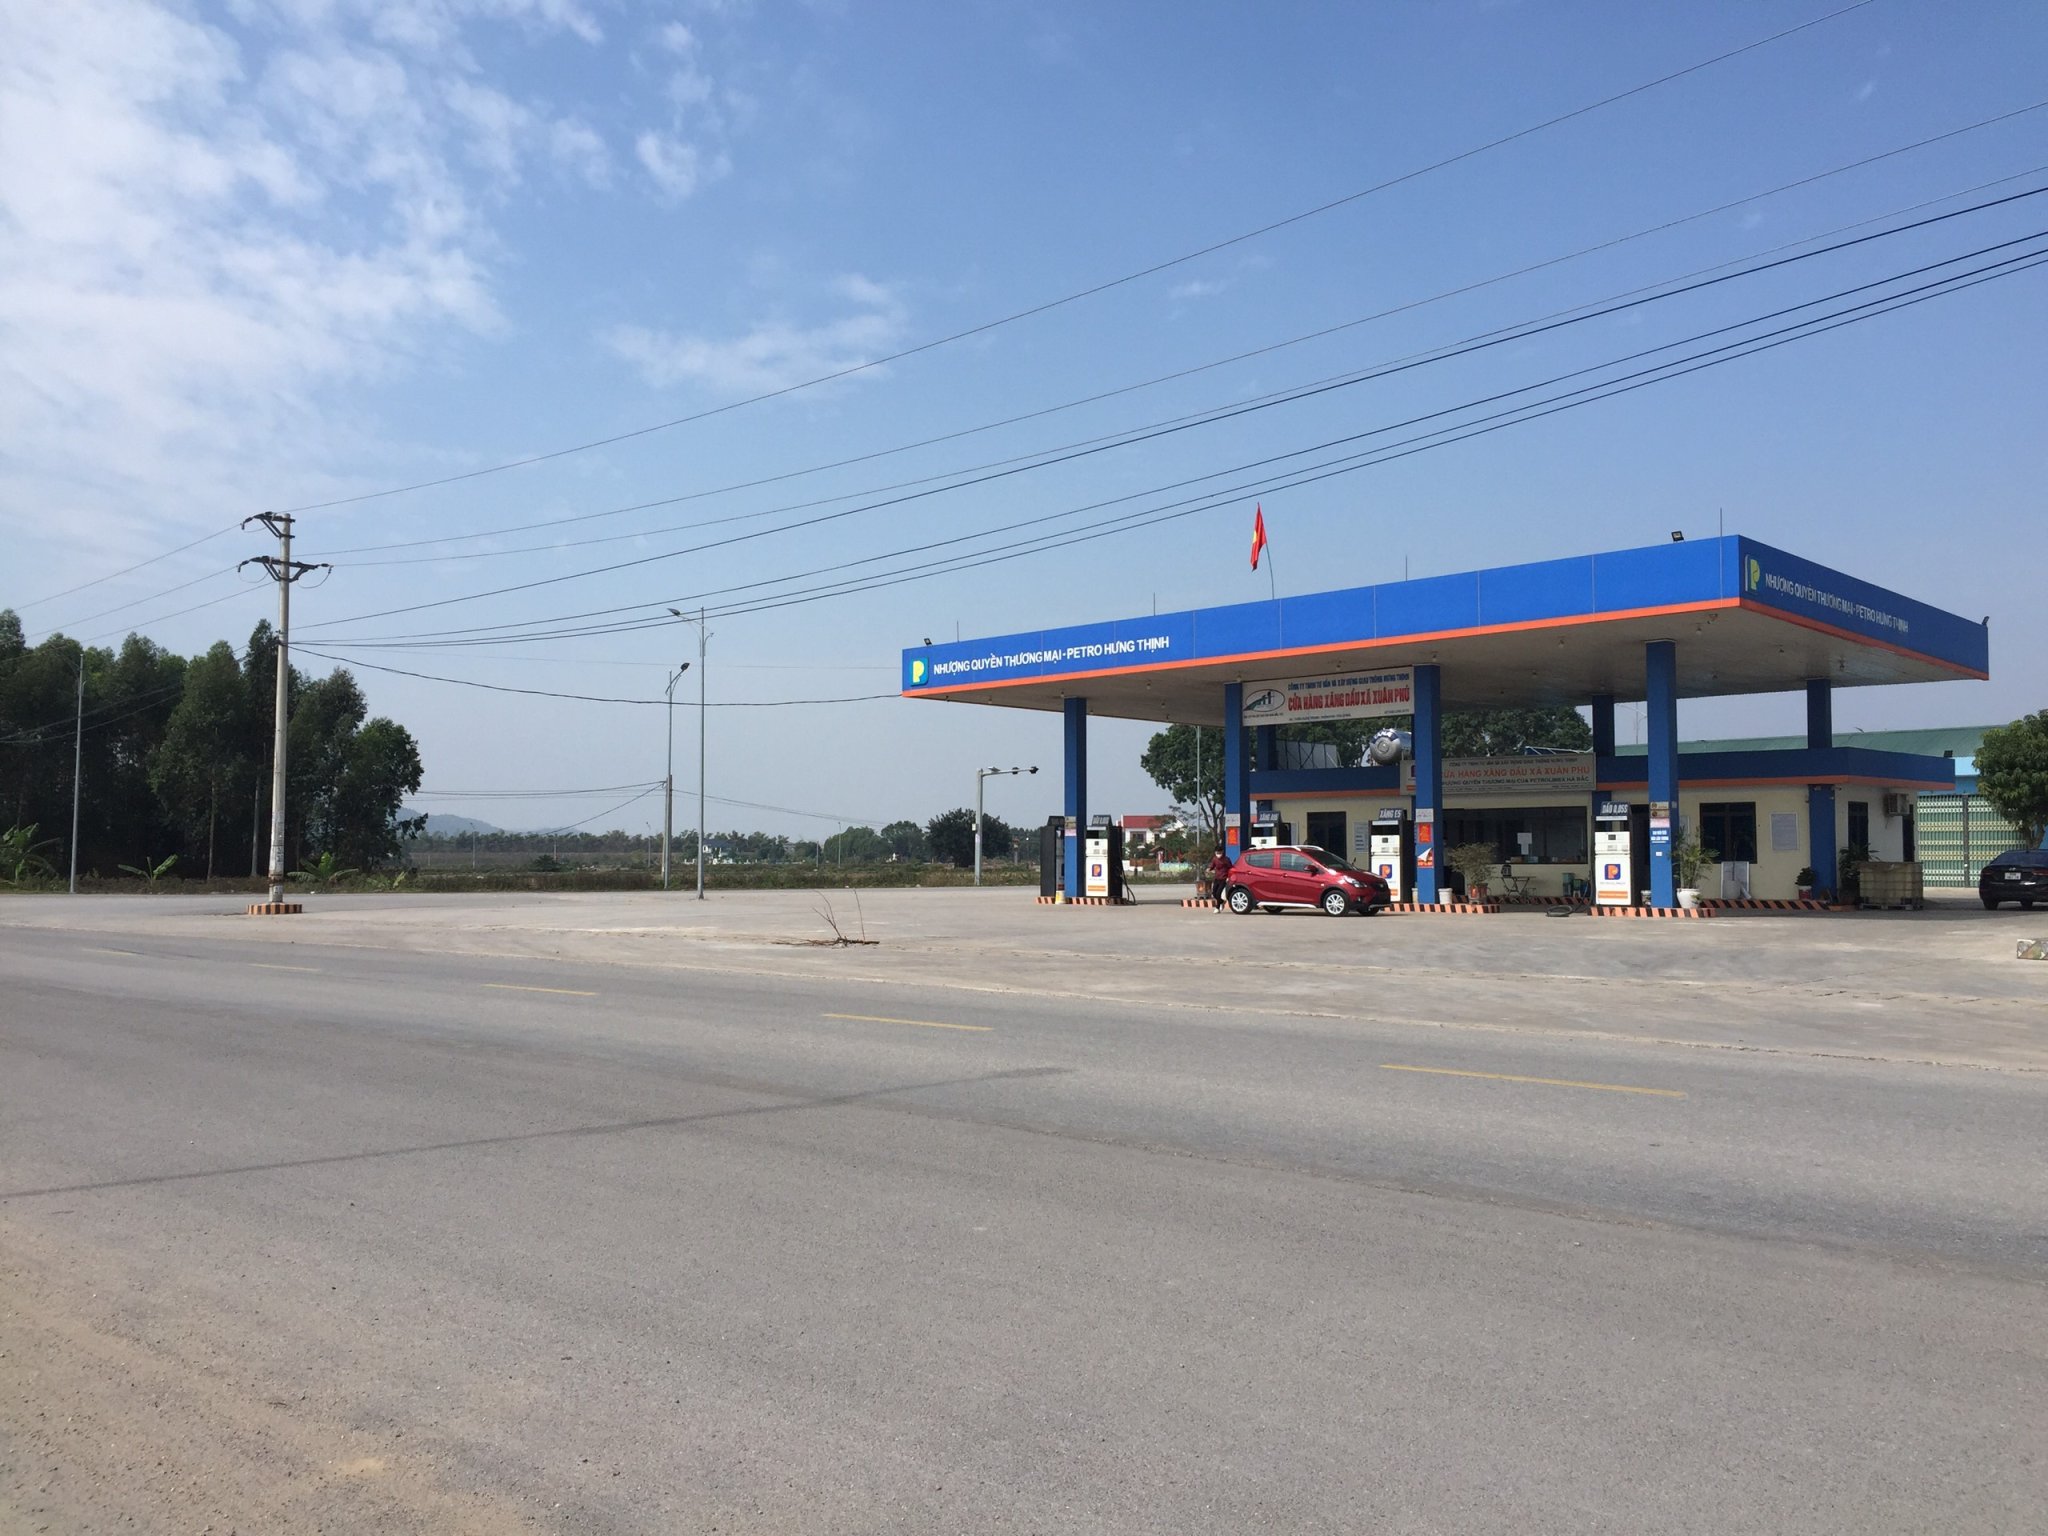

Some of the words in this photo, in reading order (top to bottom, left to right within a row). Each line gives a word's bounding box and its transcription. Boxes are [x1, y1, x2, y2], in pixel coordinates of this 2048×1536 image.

[1765, 573, 1793, 596] NHƯỢNG
[1794, 582, 1816, 603] QUYỀN
[1817, 591, 1841, 611] THƯƠNG
[1856, 604, 1875, 622] PETRO
[934, 660, 970, 676] NHƯỢNG
[971, 653, 1002, 671] QUYỀN
[1004, 651, 1042, 667] THƯƠNG
[1044, 649, 1062, 664] MẠI
[1066, 644, 1102, 660] PETRO
[1104, 640, 1135, 655] HƯNG
[1136, 636, 1169, 653] THỊNH
[1288, 692, 1302, 711] CỬA
[1304, 693, 1323, 710] HÀNG
[1324, 692, 1344, 708] XĂNG
[1372, 686, 1393, 704] XUÂN
